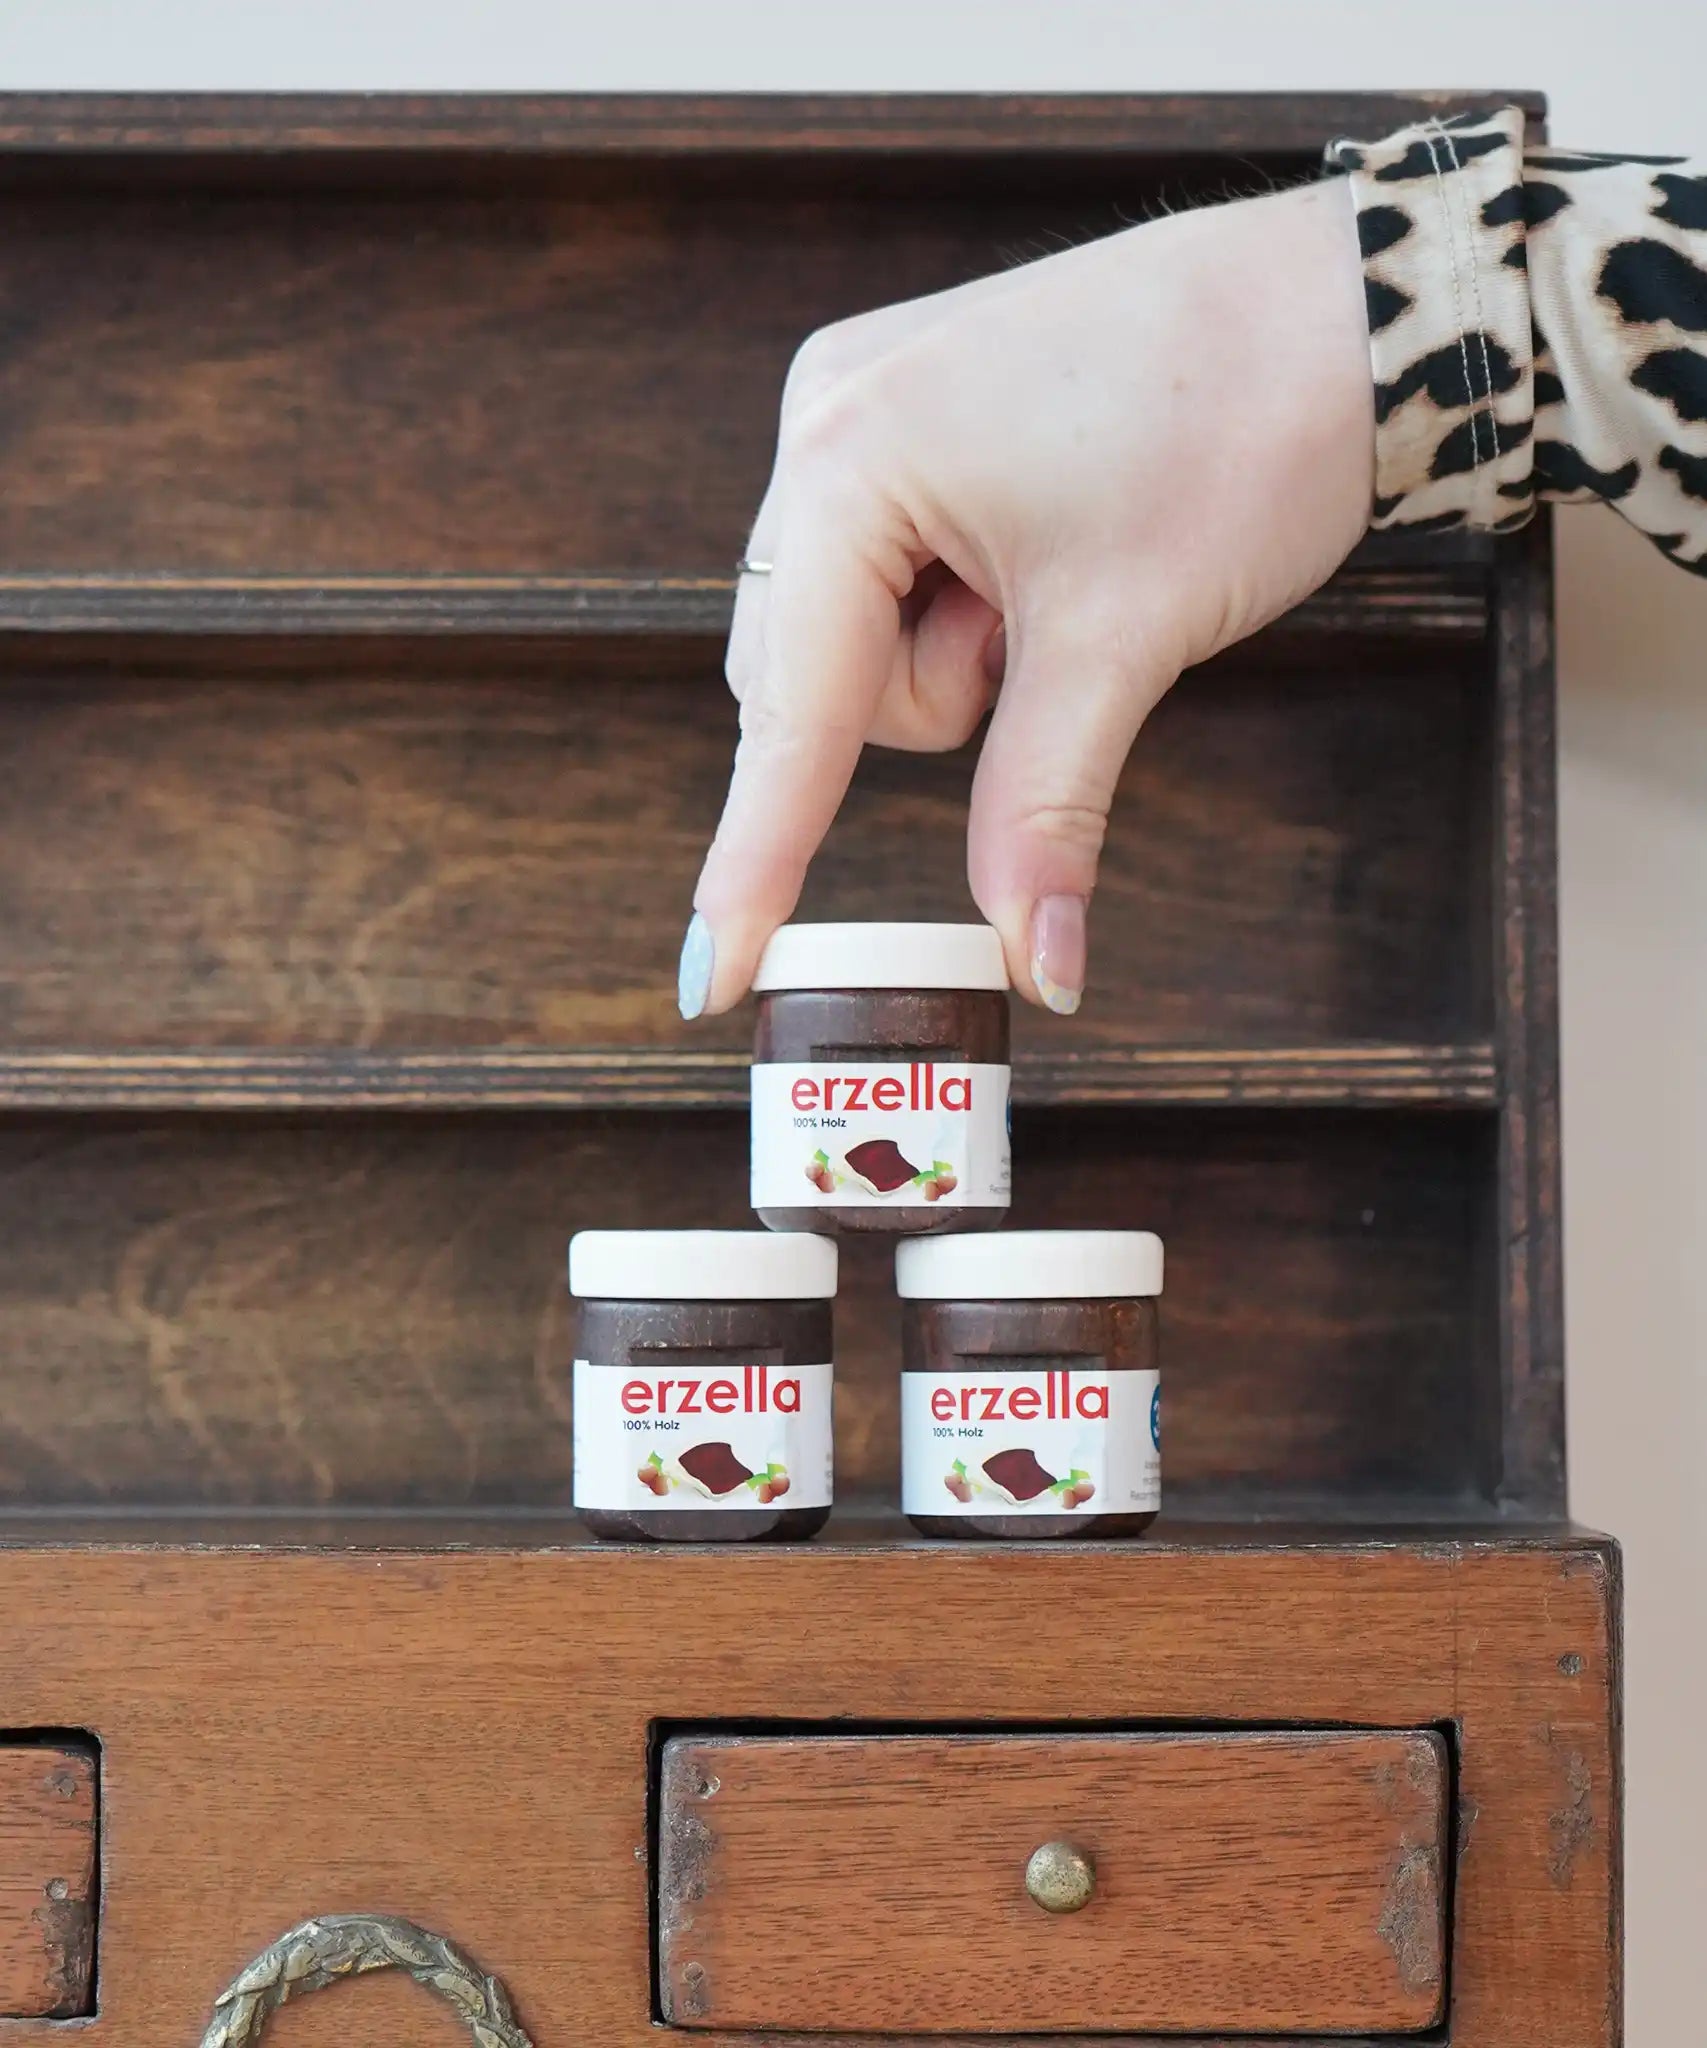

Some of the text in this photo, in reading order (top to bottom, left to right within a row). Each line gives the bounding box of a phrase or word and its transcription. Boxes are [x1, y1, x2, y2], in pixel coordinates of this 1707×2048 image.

[791, 1063, 972, 1111] erzella
[793, 1117, 847, 1128] 100% Holz
[621, 1366, 801, 1414] erzella
[931, 1371, 1109, 1421] erzella
[623, 1420, 680, 1431] 100% Holz
[933, 1427, 984, 1438] 100% Holz
